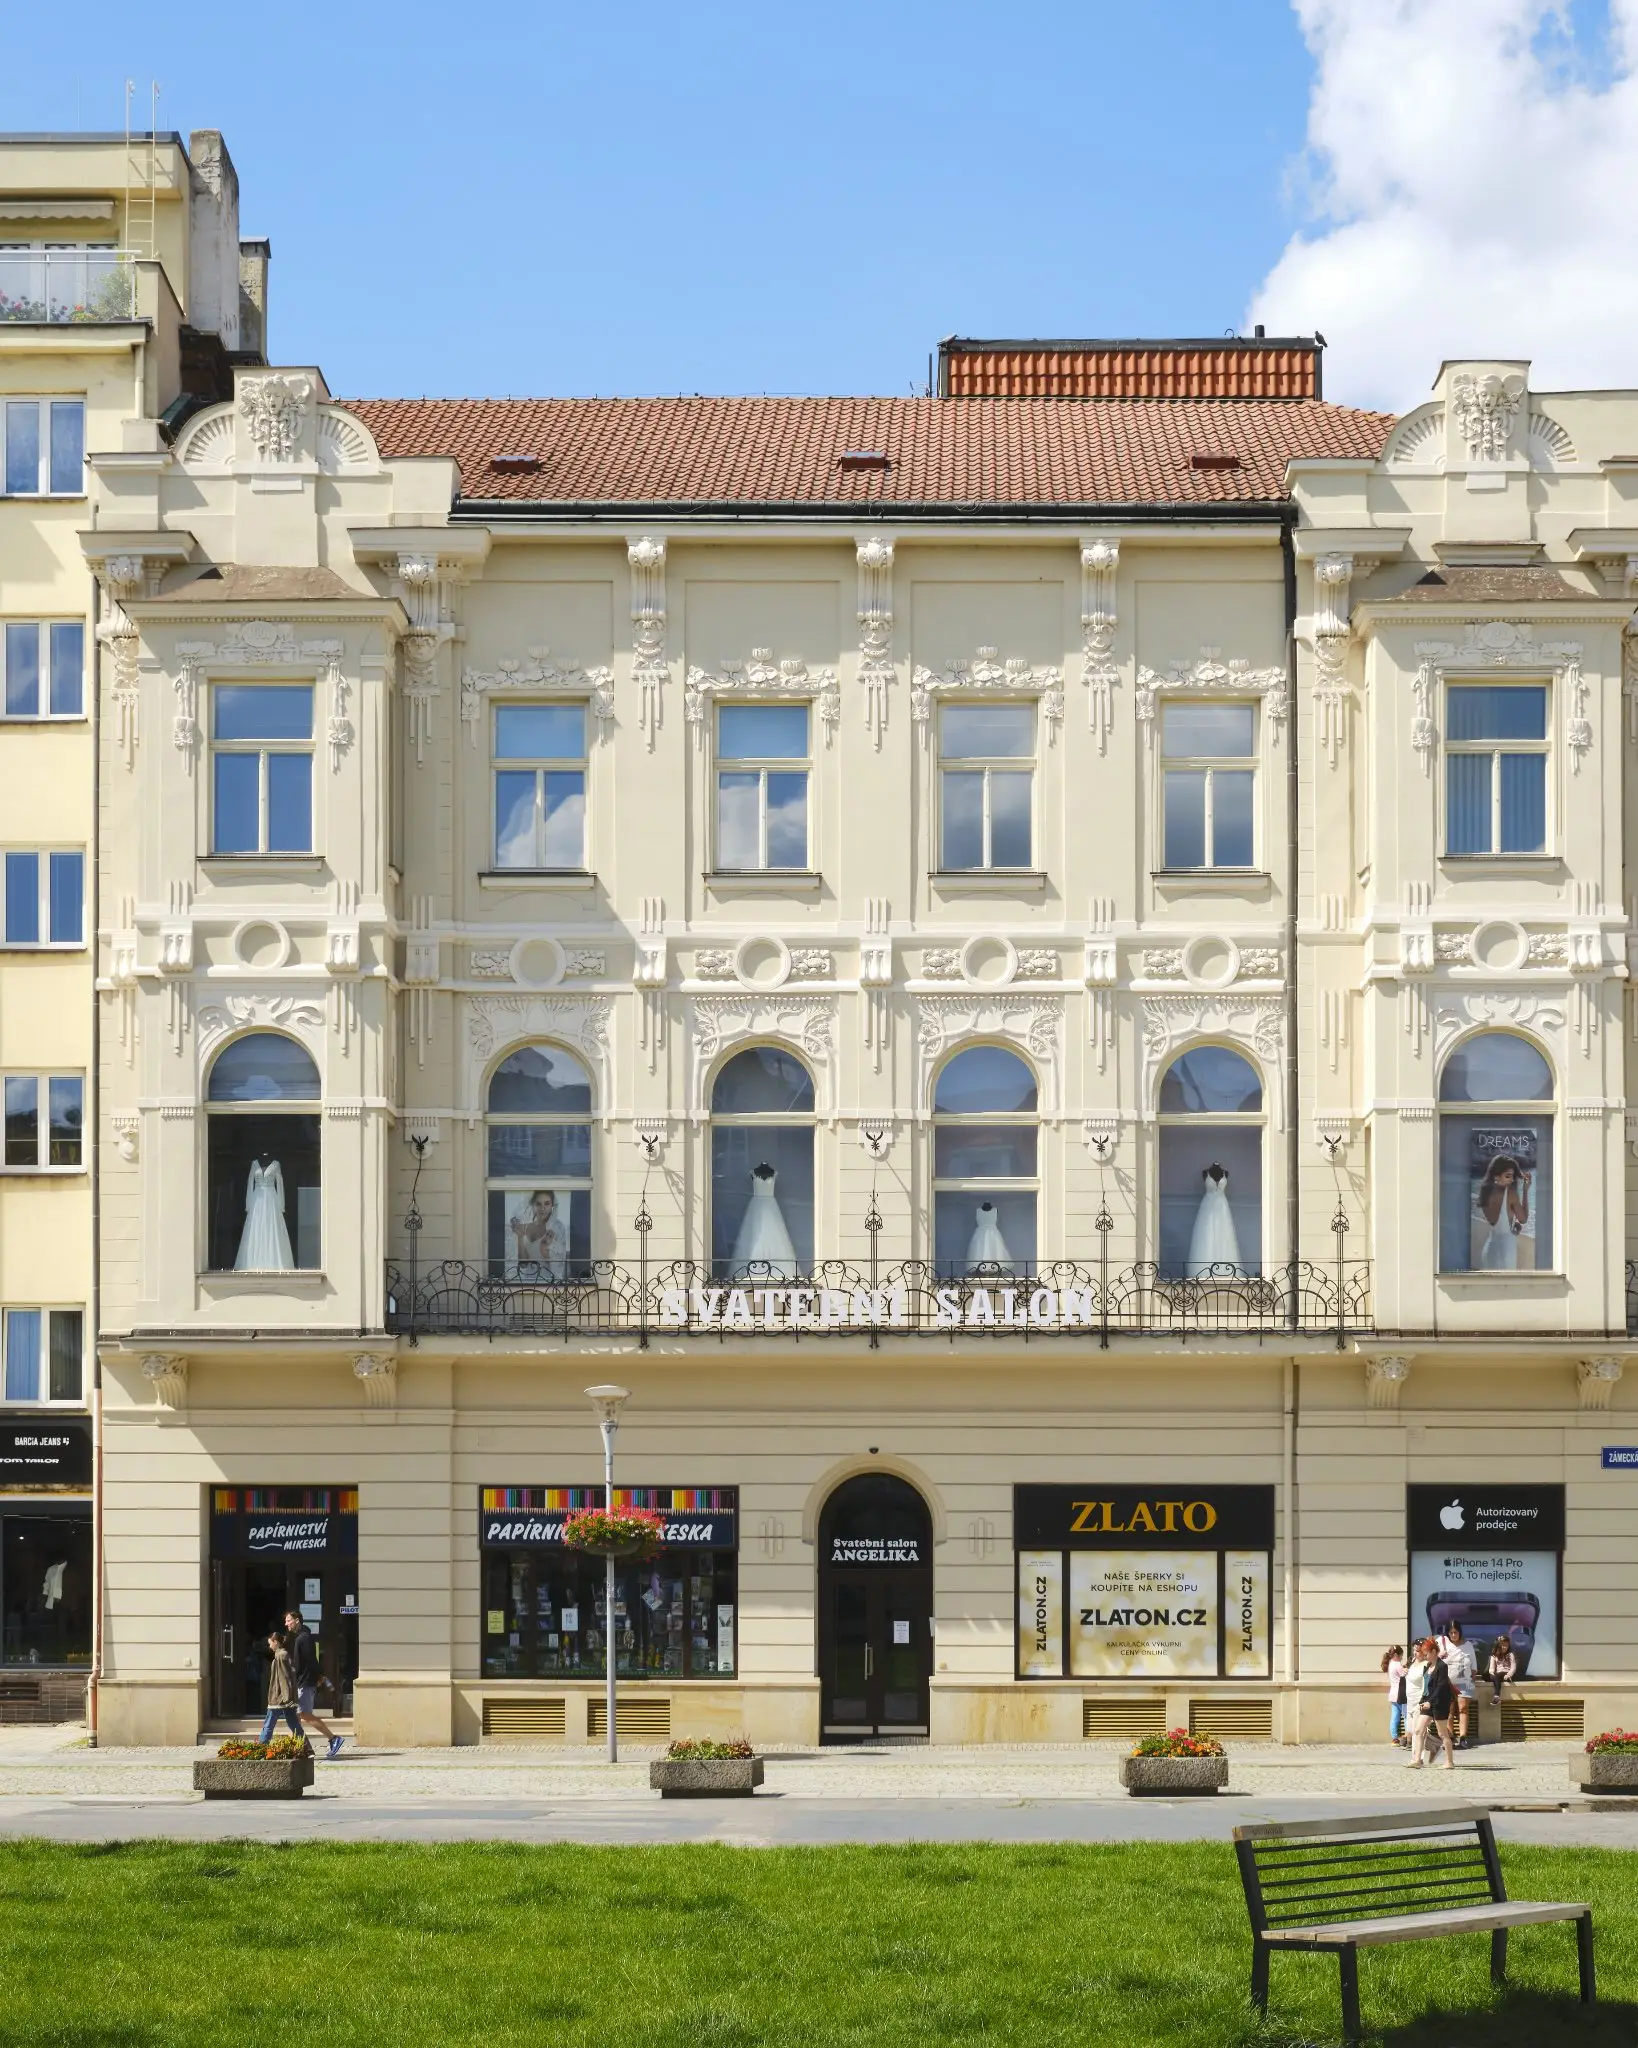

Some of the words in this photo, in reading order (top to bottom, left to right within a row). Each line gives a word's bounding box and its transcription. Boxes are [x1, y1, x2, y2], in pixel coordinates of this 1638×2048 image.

[1479, 1134, 1530, 1148] DREAMS
[661, 1282, 905, 1326] SVATEBNÍ
[936, 1288, 1094, 1325] SALON
[40, 1437, 61, 1446] JEANS
[1069, 1501, 1218, 1532] ZLATO
[1476, 1507, 1539, 1519] Autorizovaný
[248, 1518, 329, 1540] PAPÍRNICTVÍ
[1476, 1520, 1518, 1531] prodejce
[284, 1538, 327, 1550] MIKESKA
[833, 1538, 885, 1548] Svatební
[887, 1538, 917, 1548] salon
[831, 1549, 919, 1561] ANGELIKA
[1452, 1558, 1488, 1568] iPhone
[1491, 1558, 1503, 1568] 14
[1506, 1558, 1523, 1568] Pro
[1104, 1571, 1130, 1580] NAŠE
[1134, 1570, 1172, 1580] ŠPERKY
[1445, 1570, 1464, 1580] Pro.
[1467, 1570, 1478, 1580] To
[1481, 1570, 1522, 1582] nejlepší.
[1091, 1581, 1134, 1592] KOUPÍTE
[1138, 1584, 1153, 1592] NA
[1157, 1584, 1198, 1592] ESHOPU
[1036, 1576, 1047, 1651] ZLATON.CZ
[1080, 1608, 1207, 1626] ZLATON.CZ
[1242, 1576, 1253, 1652] ZLATON.CZ
